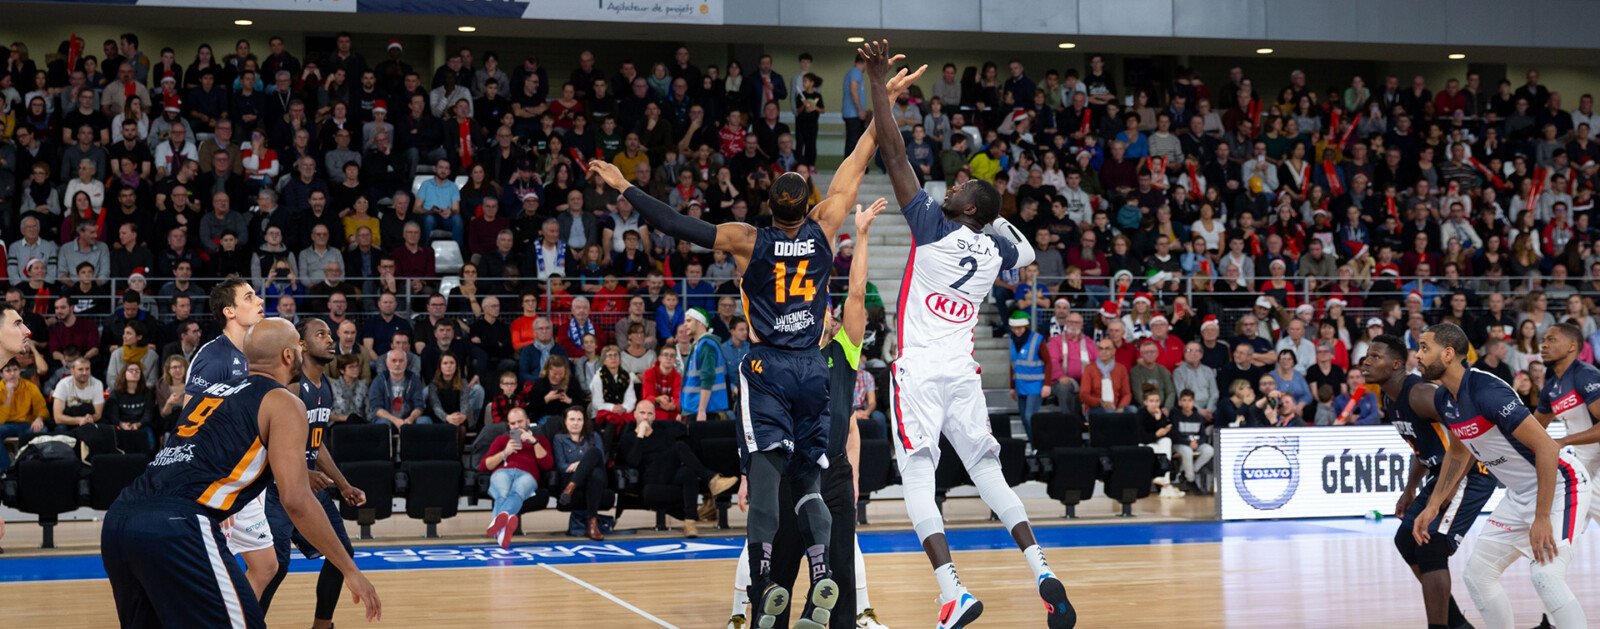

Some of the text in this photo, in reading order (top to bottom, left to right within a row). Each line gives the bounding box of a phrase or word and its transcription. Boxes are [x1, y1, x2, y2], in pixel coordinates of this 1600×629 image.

[652, 4, 663, 12] de
[665, 5, 694, 15] projets
[773, 260, 817, 303] 14
[949, 256, 978, 295] 2
[934, 295, 968, 318] KIA
[177, 396, 224, 437] 9
[311, 428, 323, 447] 10
[1244, 468, 1291, 479] VOLVO
[1321, 447, 1417, 494] GÉNÉR
